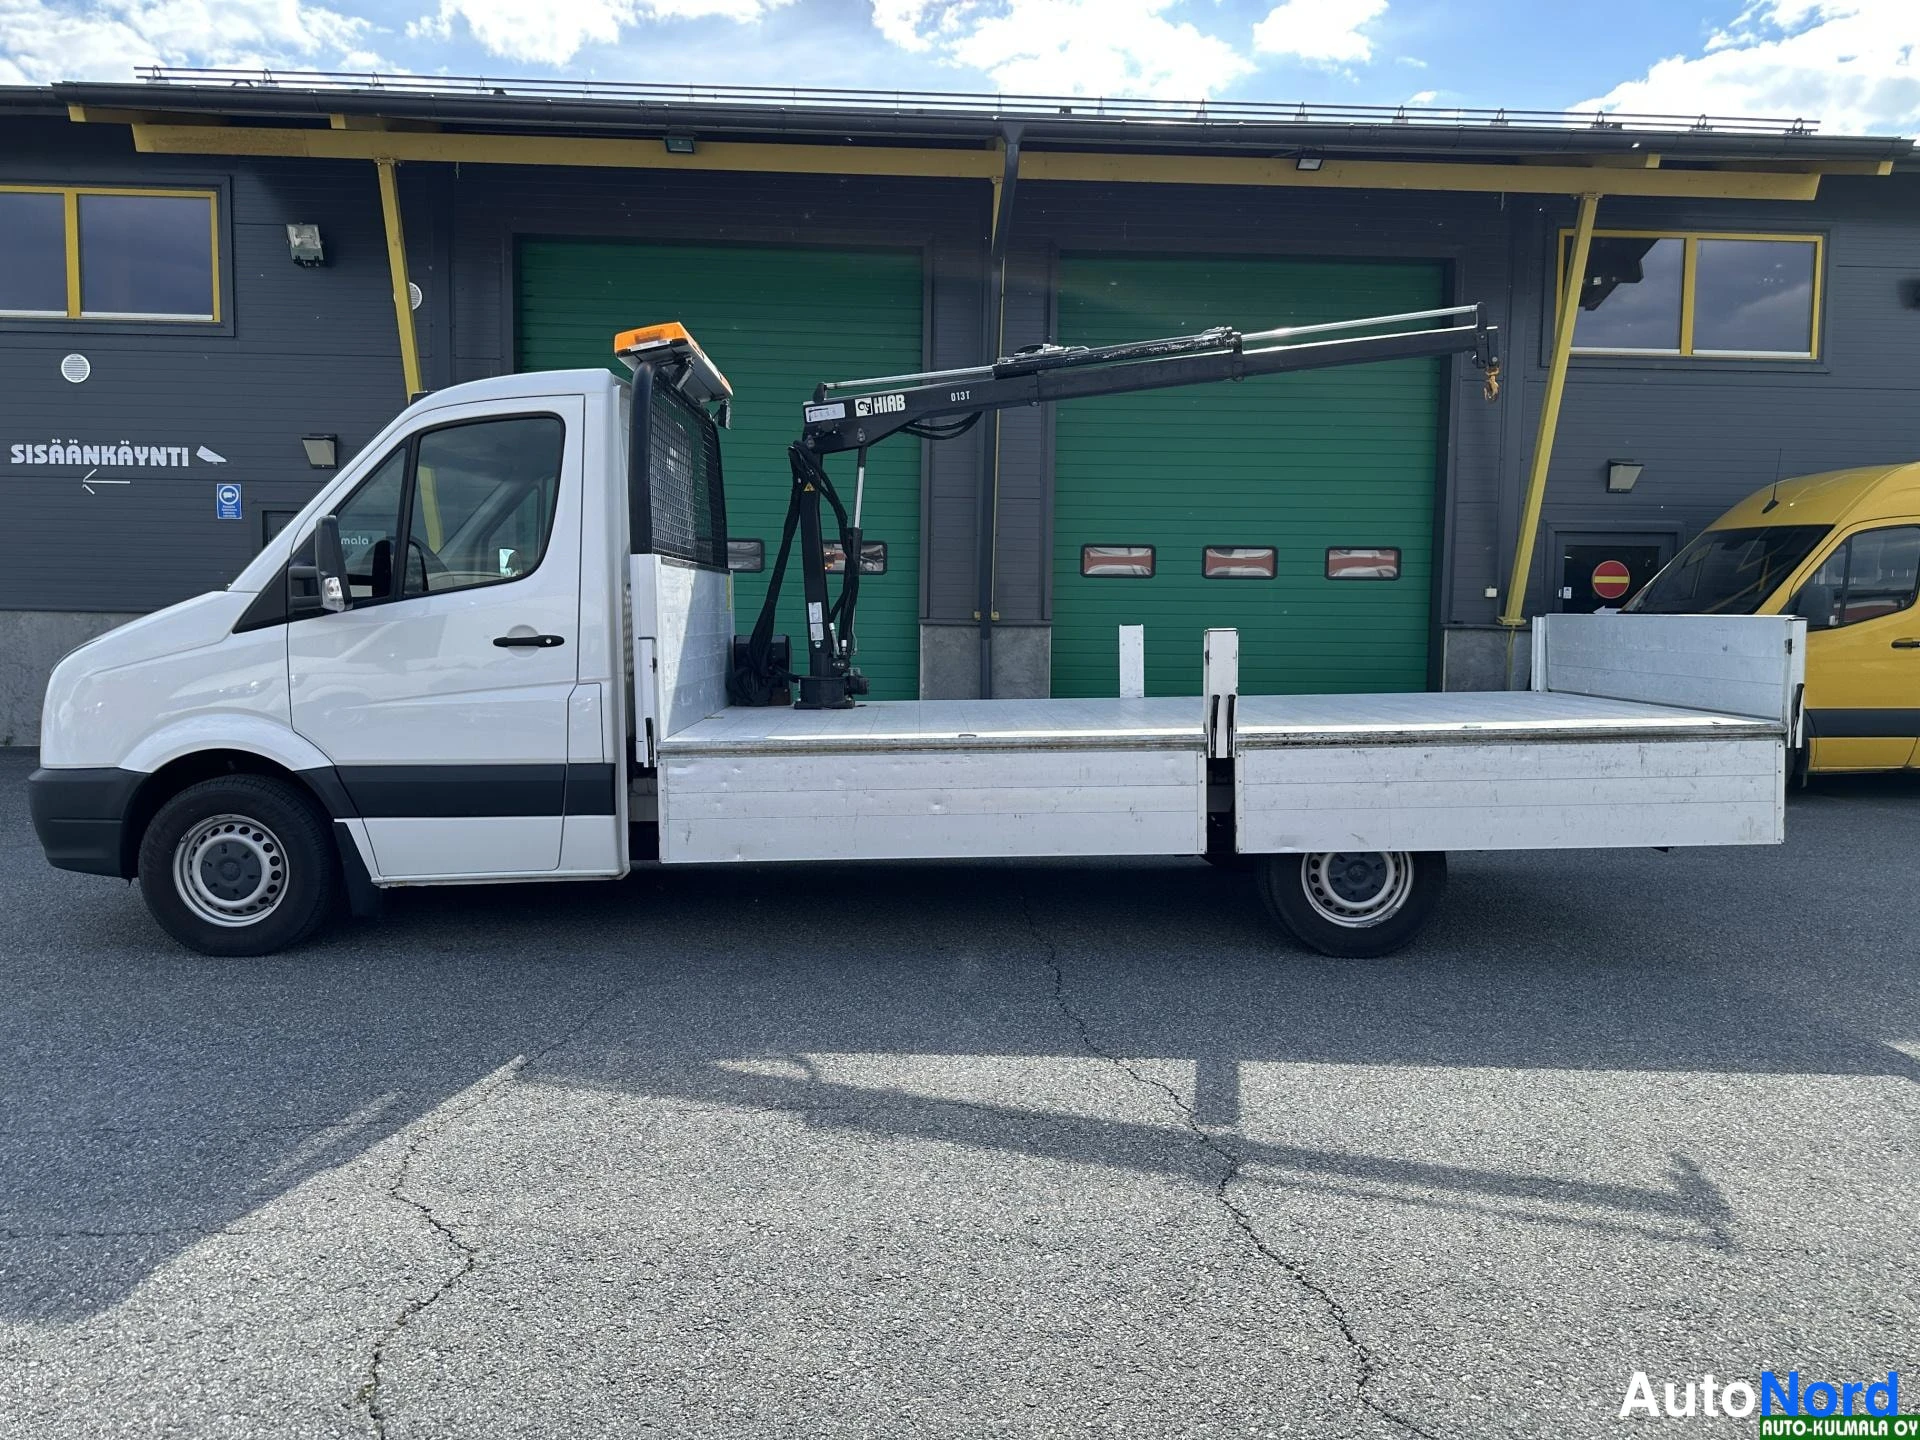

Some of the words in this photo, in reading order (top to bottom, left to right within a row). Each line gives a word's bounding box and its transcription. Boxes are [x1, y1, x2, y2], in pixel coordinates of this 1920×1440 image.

[873, 394, 906, 414] HIAB
[10, 438, 189, 467] SISÄÄNKÄYNTI
[340, 536, 369, 545] mala
